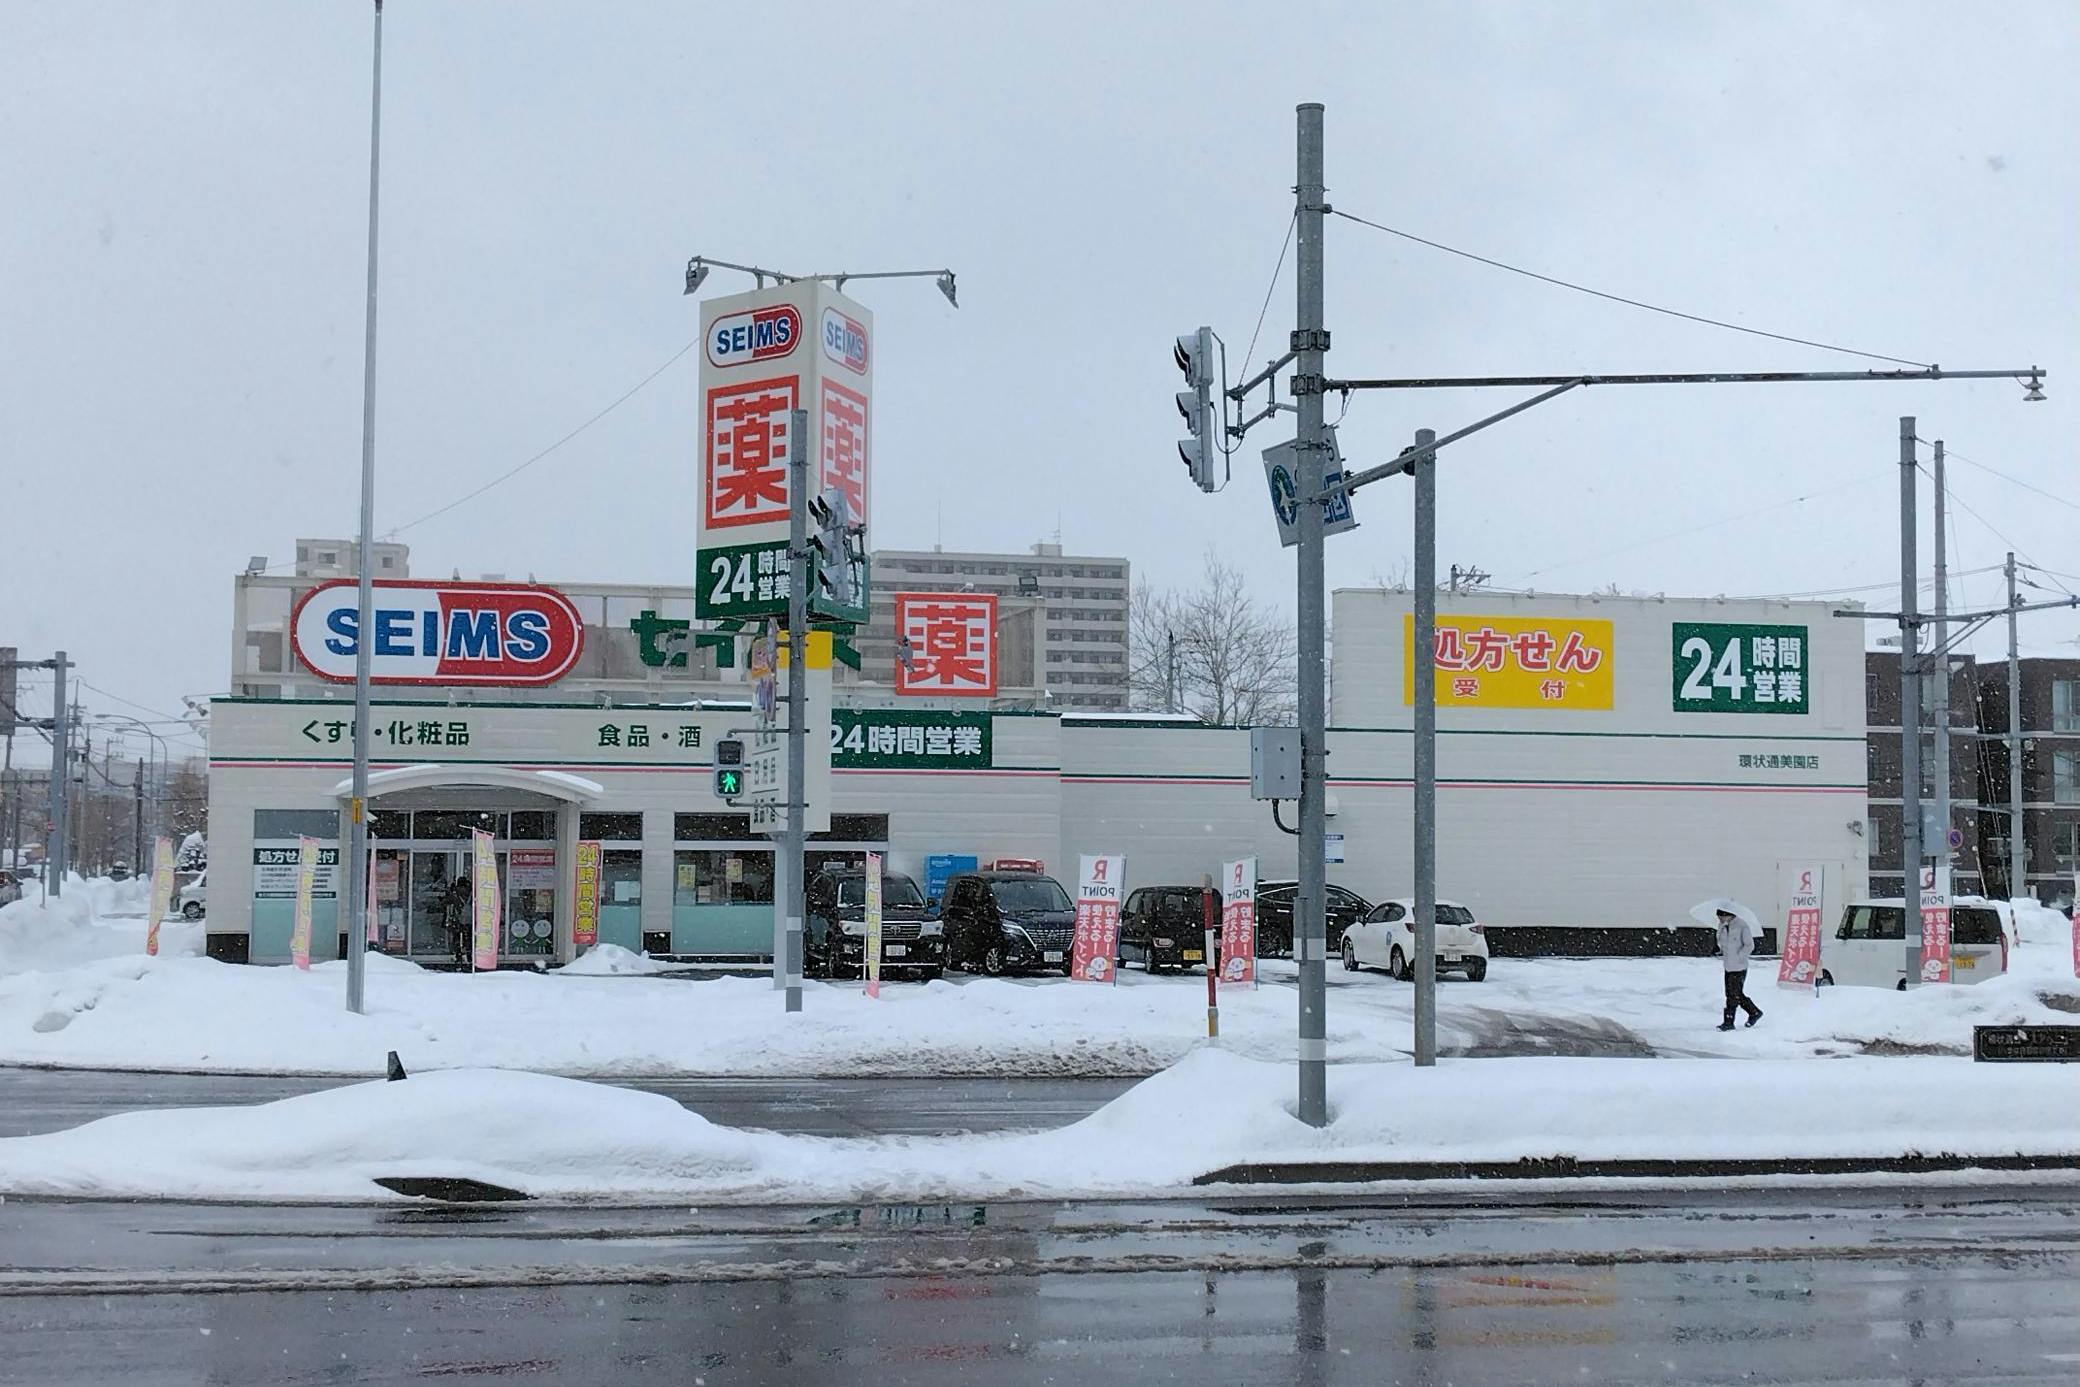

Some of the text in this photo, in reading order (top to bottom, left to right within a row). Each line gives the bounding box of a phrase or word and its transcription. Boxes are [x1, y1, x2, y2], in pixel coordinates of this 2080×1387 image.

[716, 317, 791, 355] SEIMS
[826, 320, 864, 362] SEIMS
[715, 394, 791, 513] 薬
[824, 397, 863, 518] 薬
[709, 553, 755, 605] 24
[757, 549, 791, 575] 時間
[757, 574, 792, 601] 営業
[325, 608, 551, 663] SEIMS
[630, 610, 861, 672] セイ
[907, 604, 986, 686] 薬
[1433, 628, 1602, 673] 処方せん
[1752, 636, 1801, 669] 時間
[1680, 636, 1747, 700] 24
[1752, 670, 1802, 704] 営業
[302, 719, 470, 746] くす・化粧品
[598, 724, 701, 748] 食品・酒
[831, 724, 982, 756] 24時間営業
[258, 850, 336, 864] 処方せ付
